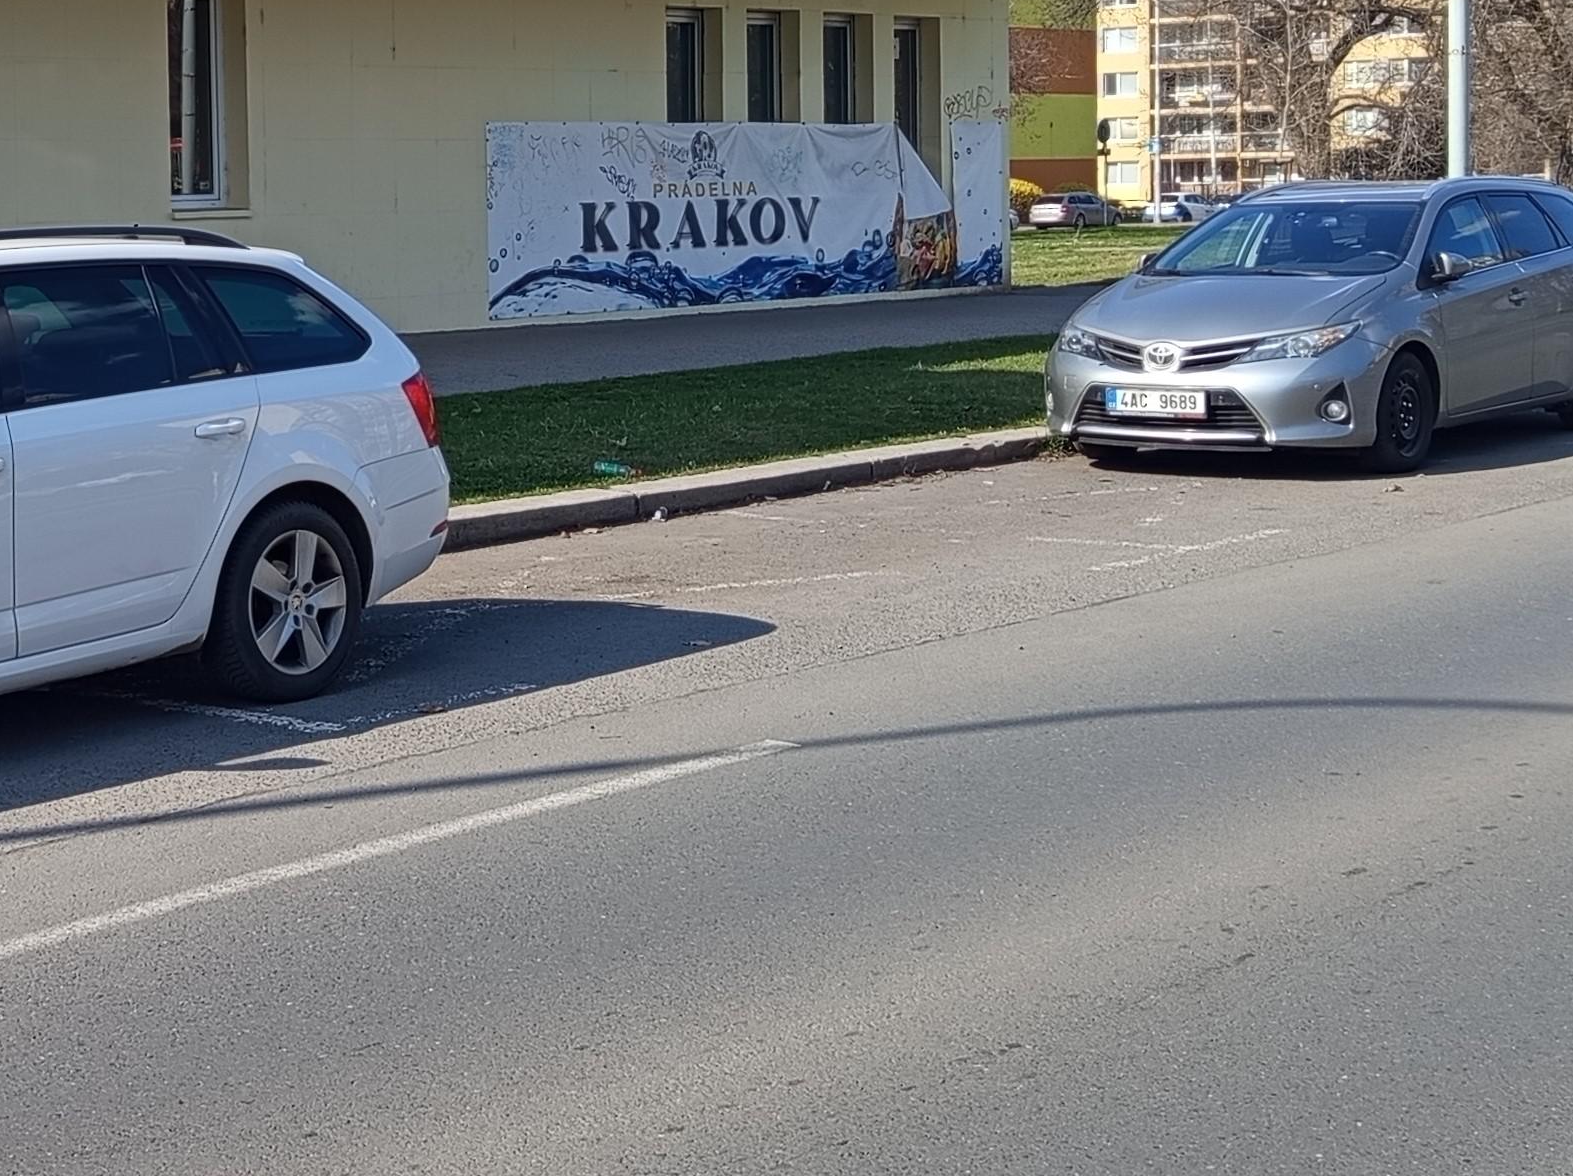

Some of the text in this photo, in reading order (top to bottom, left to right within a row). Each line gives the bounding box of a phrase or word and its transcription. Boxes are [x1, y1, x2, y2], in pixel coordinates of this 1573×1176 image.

[653, 180, 757, 198] PRÁDELNA
[580, 197, 820, 252] KRAKOV
[1121, 392, 1197, 410] 4AC 9689
